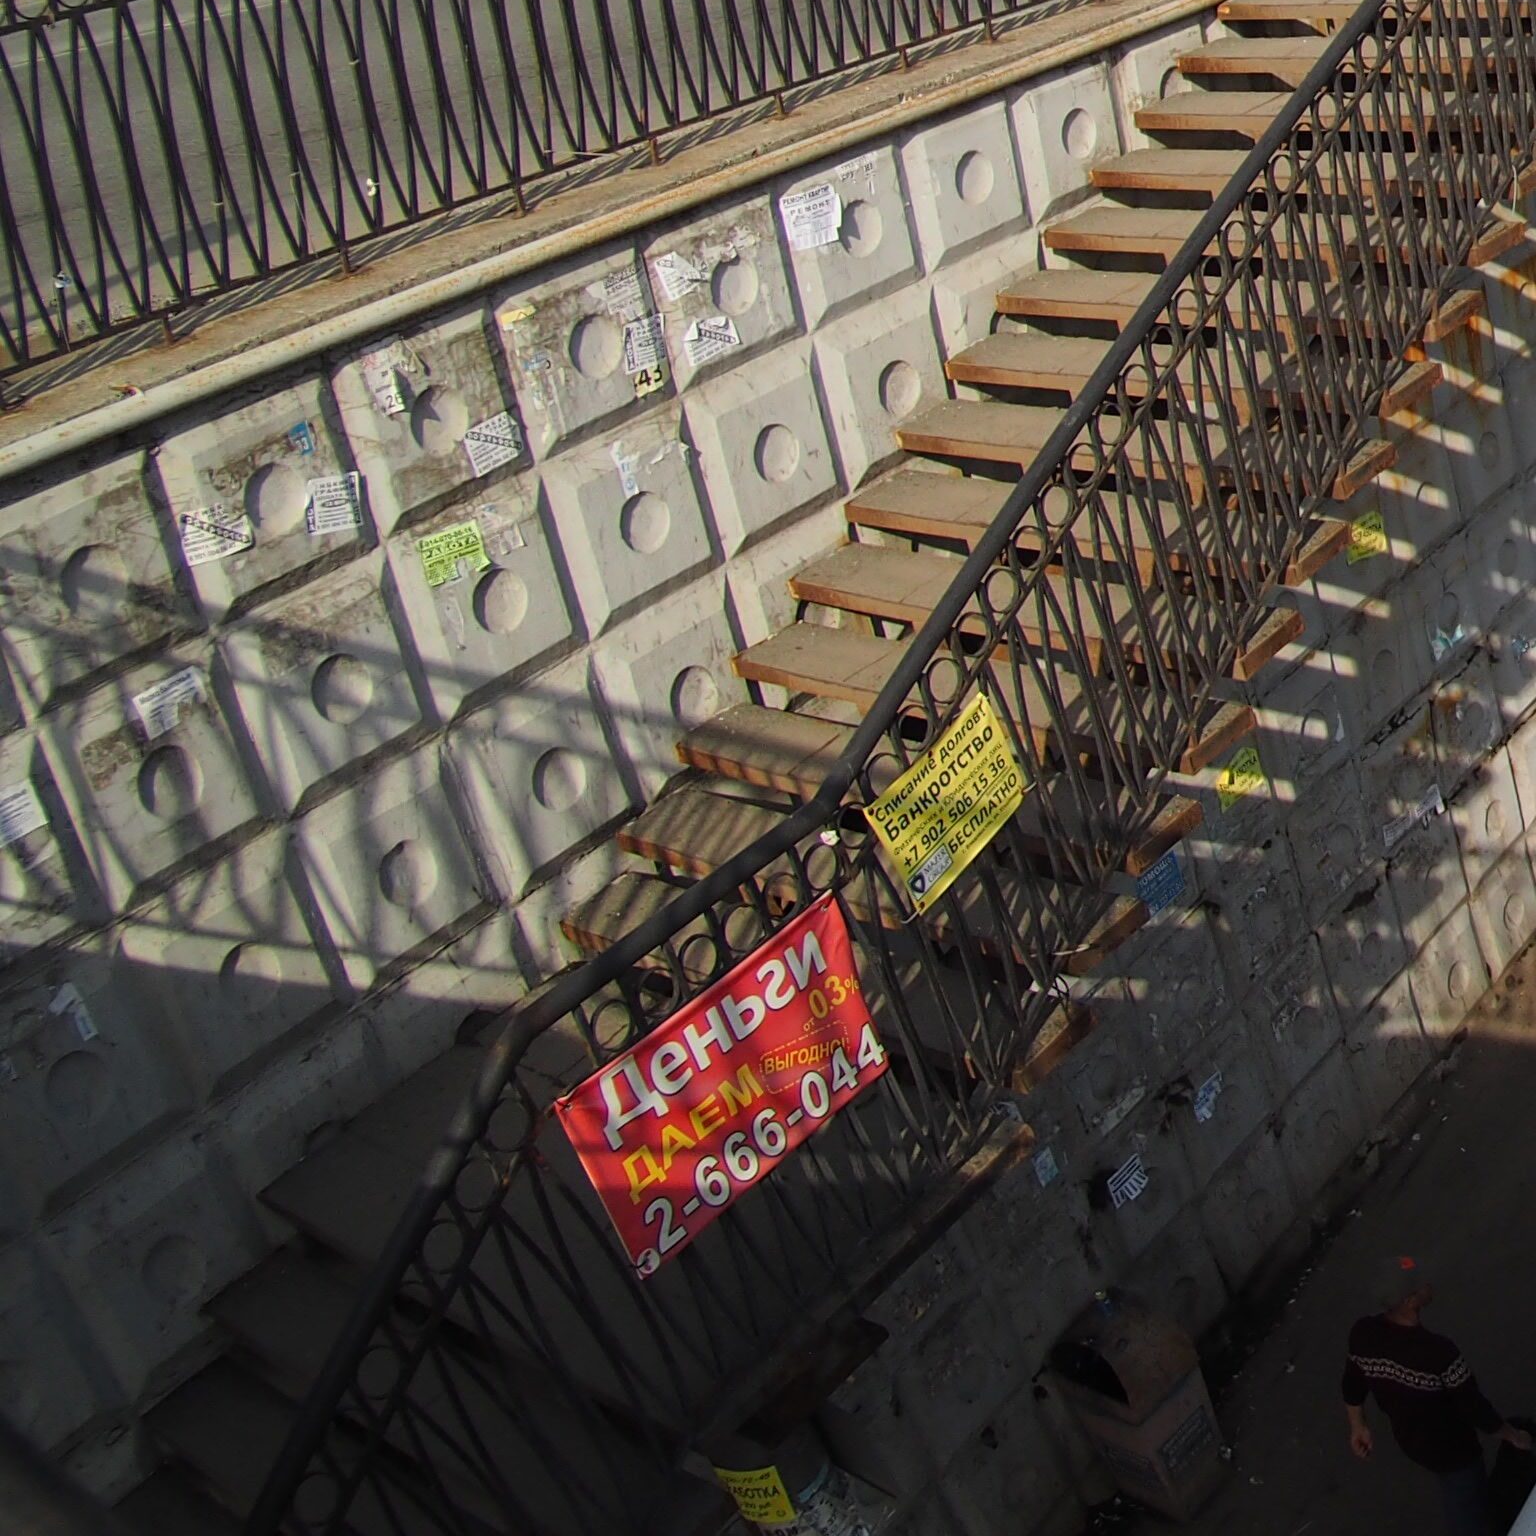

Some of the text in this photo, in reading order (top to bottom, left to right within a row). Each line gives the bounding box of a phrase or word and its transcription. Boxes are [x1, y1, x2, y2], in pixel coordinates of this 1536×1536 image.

[790, 199, 830, 216] РЕМОНТ
[875, 757, 937, 822] Списание
[938, 704, 987, 763] долгов!
[884, 726, 993, 842] Банкротство
[904, 846, 919, 867] +7
[922, 820, 947, 850] 902
[950, 792, 973, 823] 506
[973, 776, 989, 797] 15
[991, 755, 1006, 777] 36
[949, 772, 1017, 854] БЕСПЛАТНО
[803, 1016, 816, 1033] от
[622, 1062, 764, 1206] ДАЕМ
[644, 1021, 886, 1256] 2-666-044
